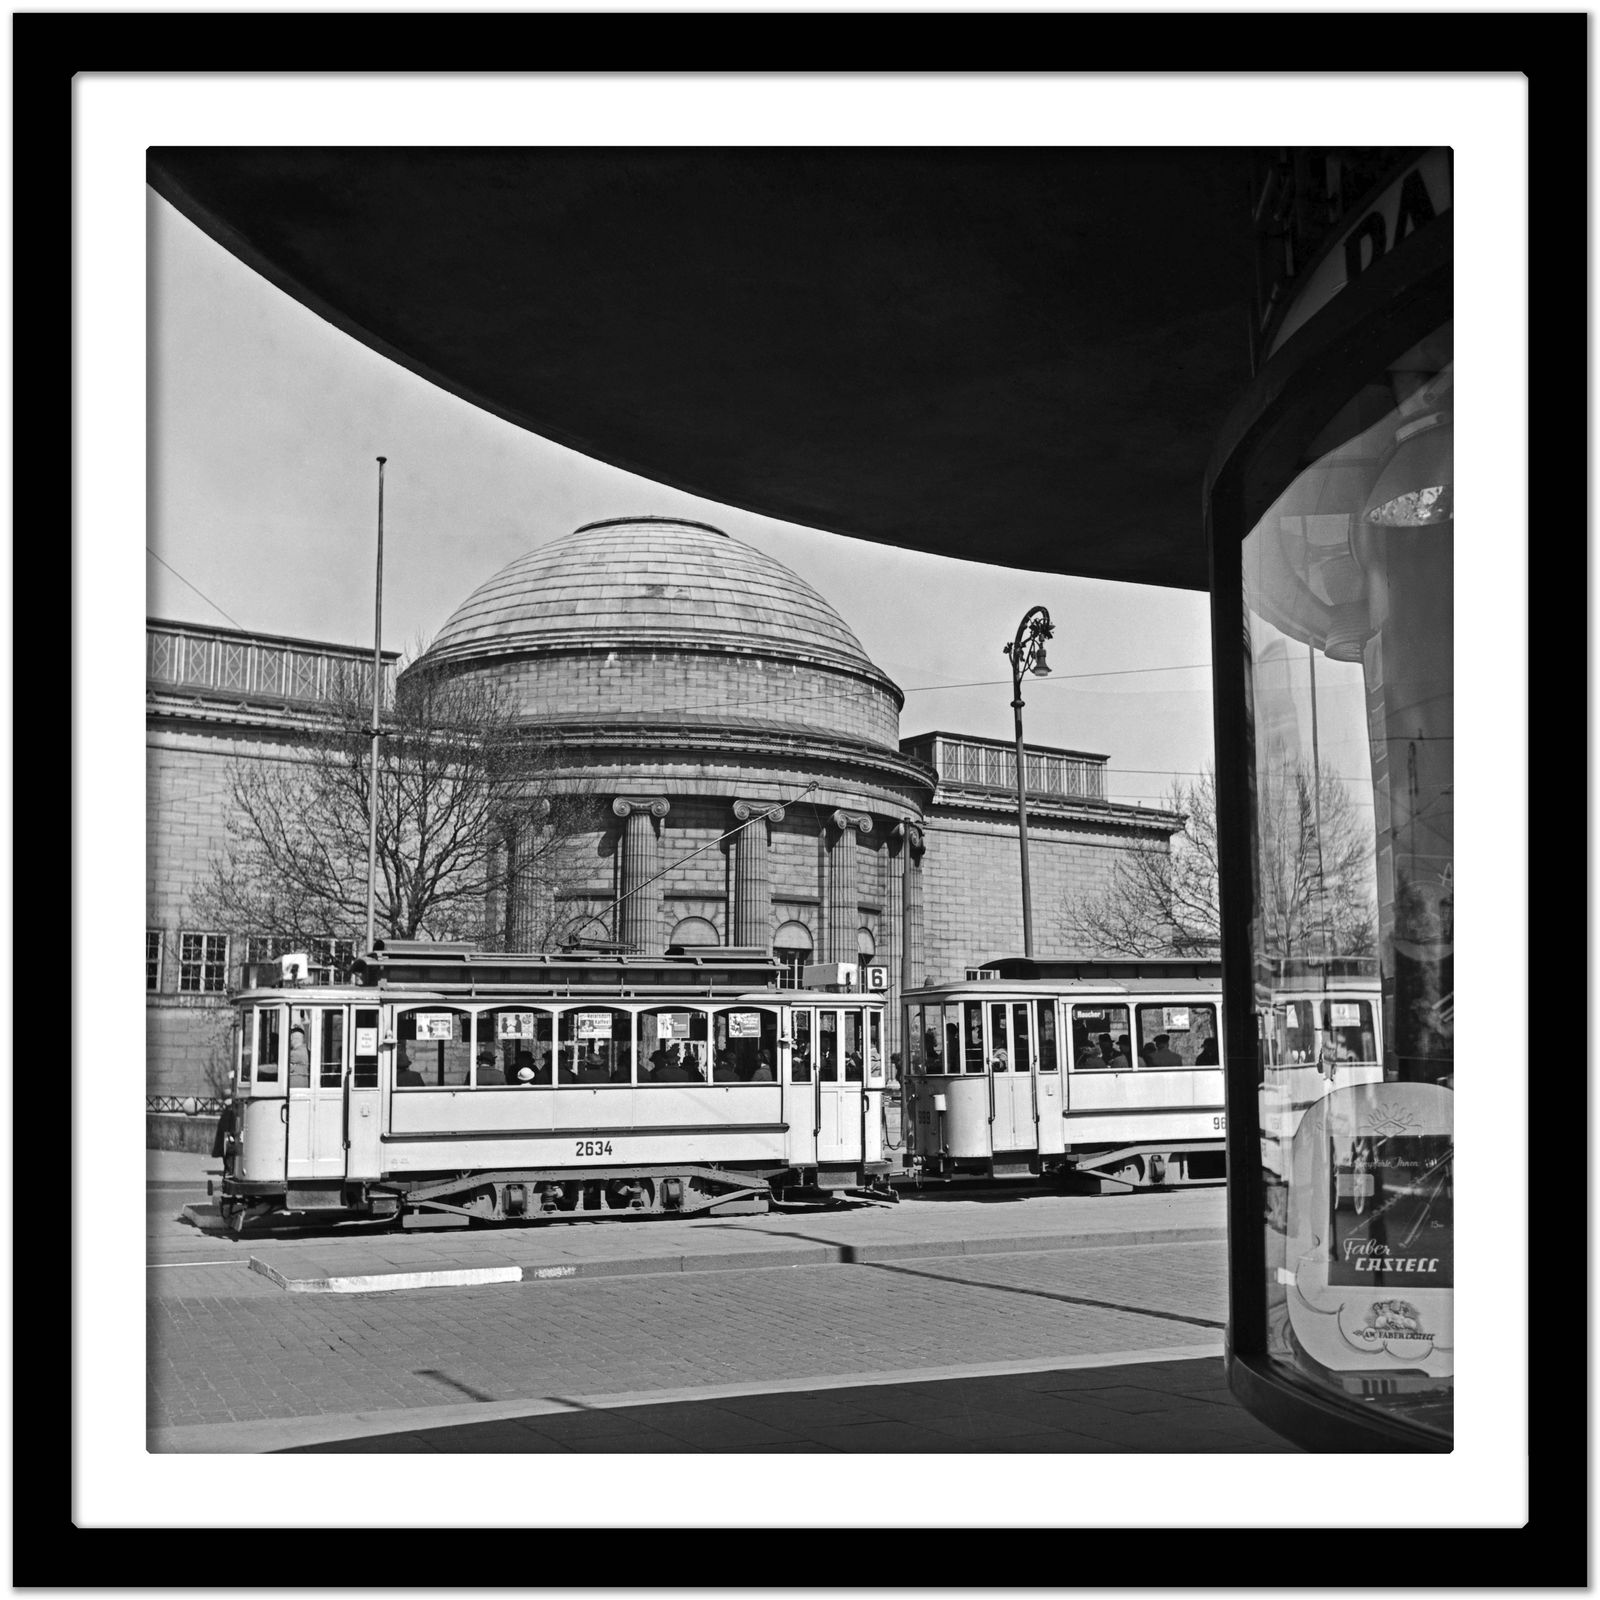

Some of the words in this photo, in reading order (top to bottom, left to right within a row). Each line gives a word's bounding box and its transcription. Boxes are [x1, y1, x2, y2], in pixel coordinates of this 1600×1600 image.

[871, 968, 883, 987] 6
[575, 1140, 613, 1157] 2634
[1343, 1237, 1392, 1261] Faber
[1355, 1257, 1439, 1273] CASTELL
[1378, 1331, 1405, 1340] FABER
